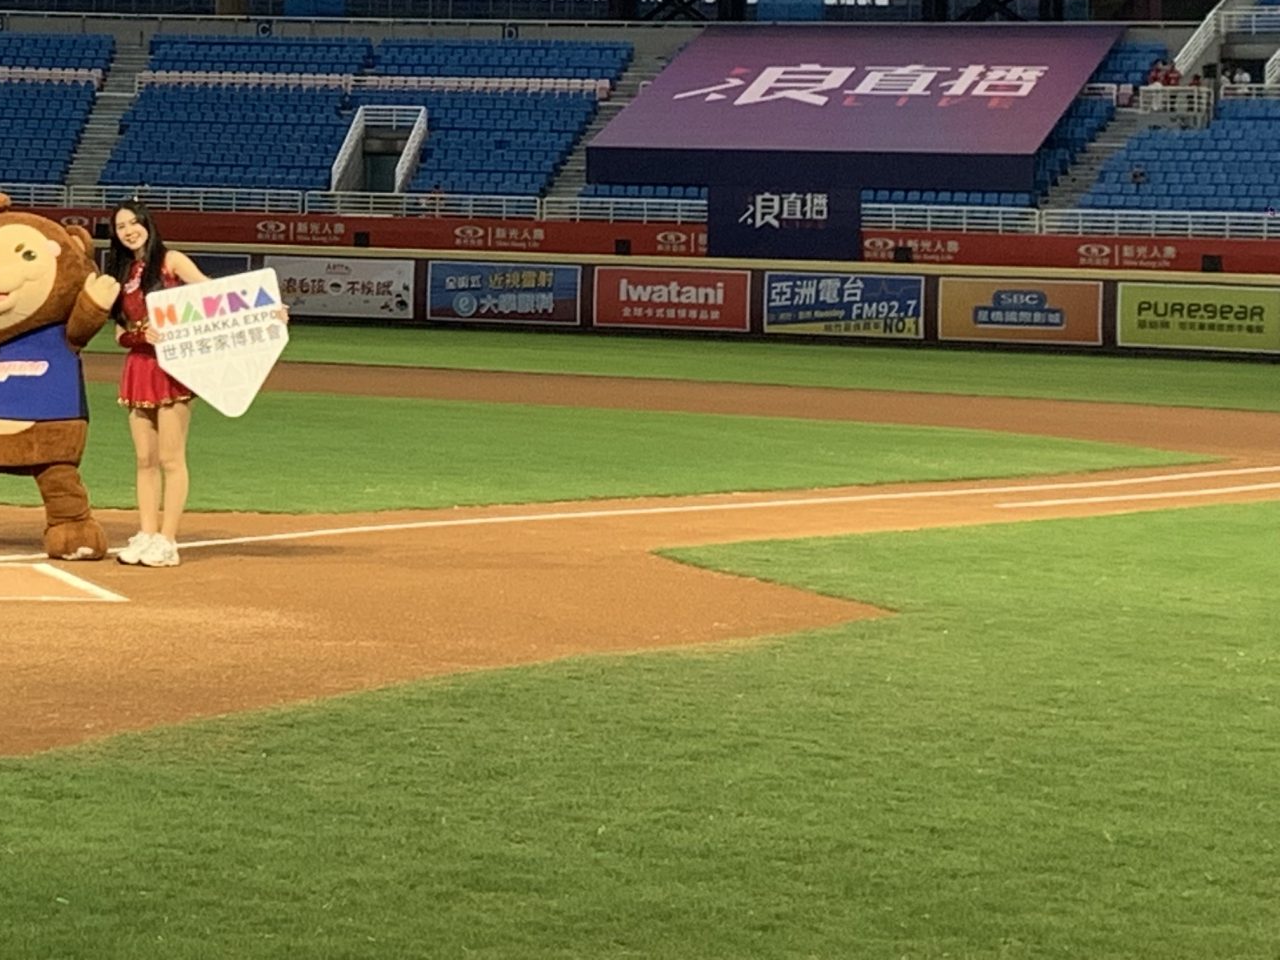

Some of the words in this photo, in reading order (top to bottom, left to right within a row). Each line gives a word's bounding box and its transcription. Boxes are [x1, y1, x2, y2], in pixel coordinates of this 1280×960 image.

[259, 24, 271, 36] C
[505, 25, 517, 38] D
[672, 63, 1049, 106] 浪直播
[738, 192, 829, 229] 浪直播
[619, 278, 725, 305] Iwatani
[769, 276, 865, 307] 亞洲電台
[1000, 292, 1039, 305] SBC
[851, 300, 917, 319] FM92.7
[160, 327, 190, 341] 2023
[193, 318, 241, 335] HAKKA
[243, 309, 278, 325] EXPO
[162, 323, 282, 361] 世界客家博覽會
